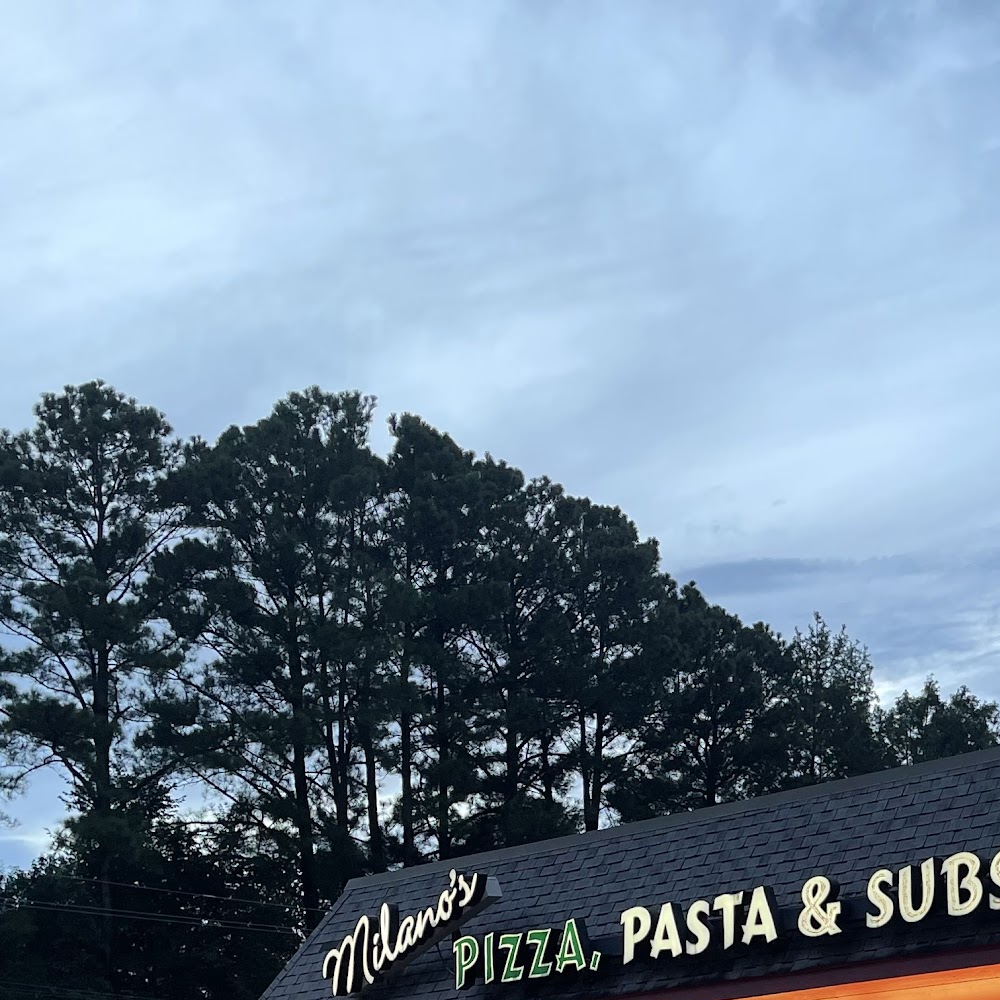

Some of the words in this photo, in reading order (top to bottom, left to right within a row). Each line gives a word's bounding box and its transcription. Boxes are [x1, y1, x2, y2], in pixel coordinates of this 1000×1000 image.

[322, 868, 478, 996] Milano's
[619, 885, 778, 965] PASTA
[798, 875, 842, 938] &
